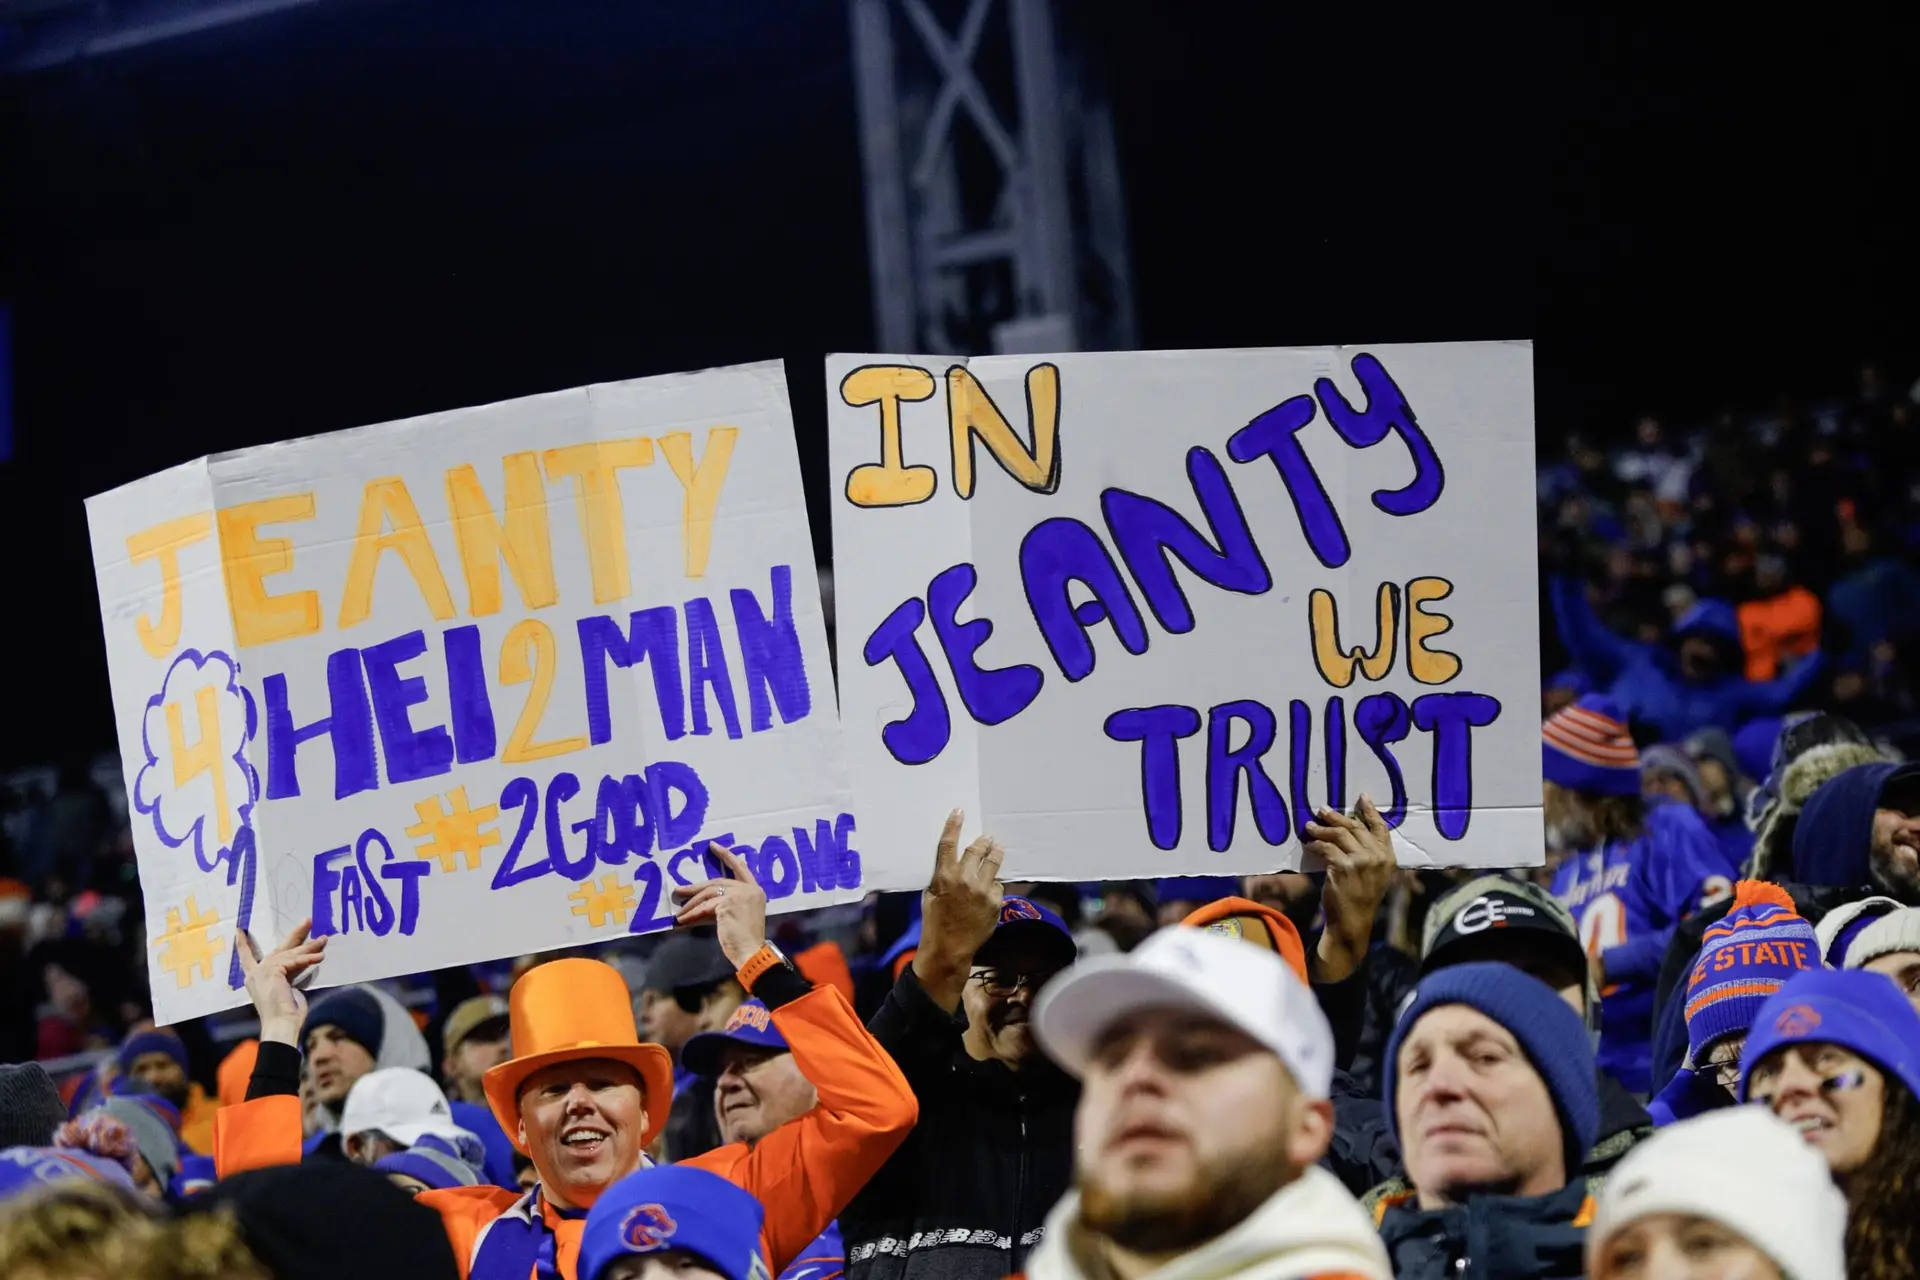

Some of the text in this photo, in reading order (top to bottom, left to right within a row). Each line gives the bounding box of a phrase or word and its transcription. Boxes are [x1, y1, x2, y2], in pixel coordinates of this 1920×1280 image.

[840, 362, 1061, 508] IN
[126, 425, 740, 660] JEANTY
[863, 352, 1445, 765] JEANTY
[263, 565, 811, 801] HEI2MAN
[1308, 576, 1463, 688] WE
[164, 685, 232, 844] 4
[1104, 692, 1502, 852] TRUST
[310, 828, 431, 940] FAST
[1714, 941, 1812, 972] STATE
